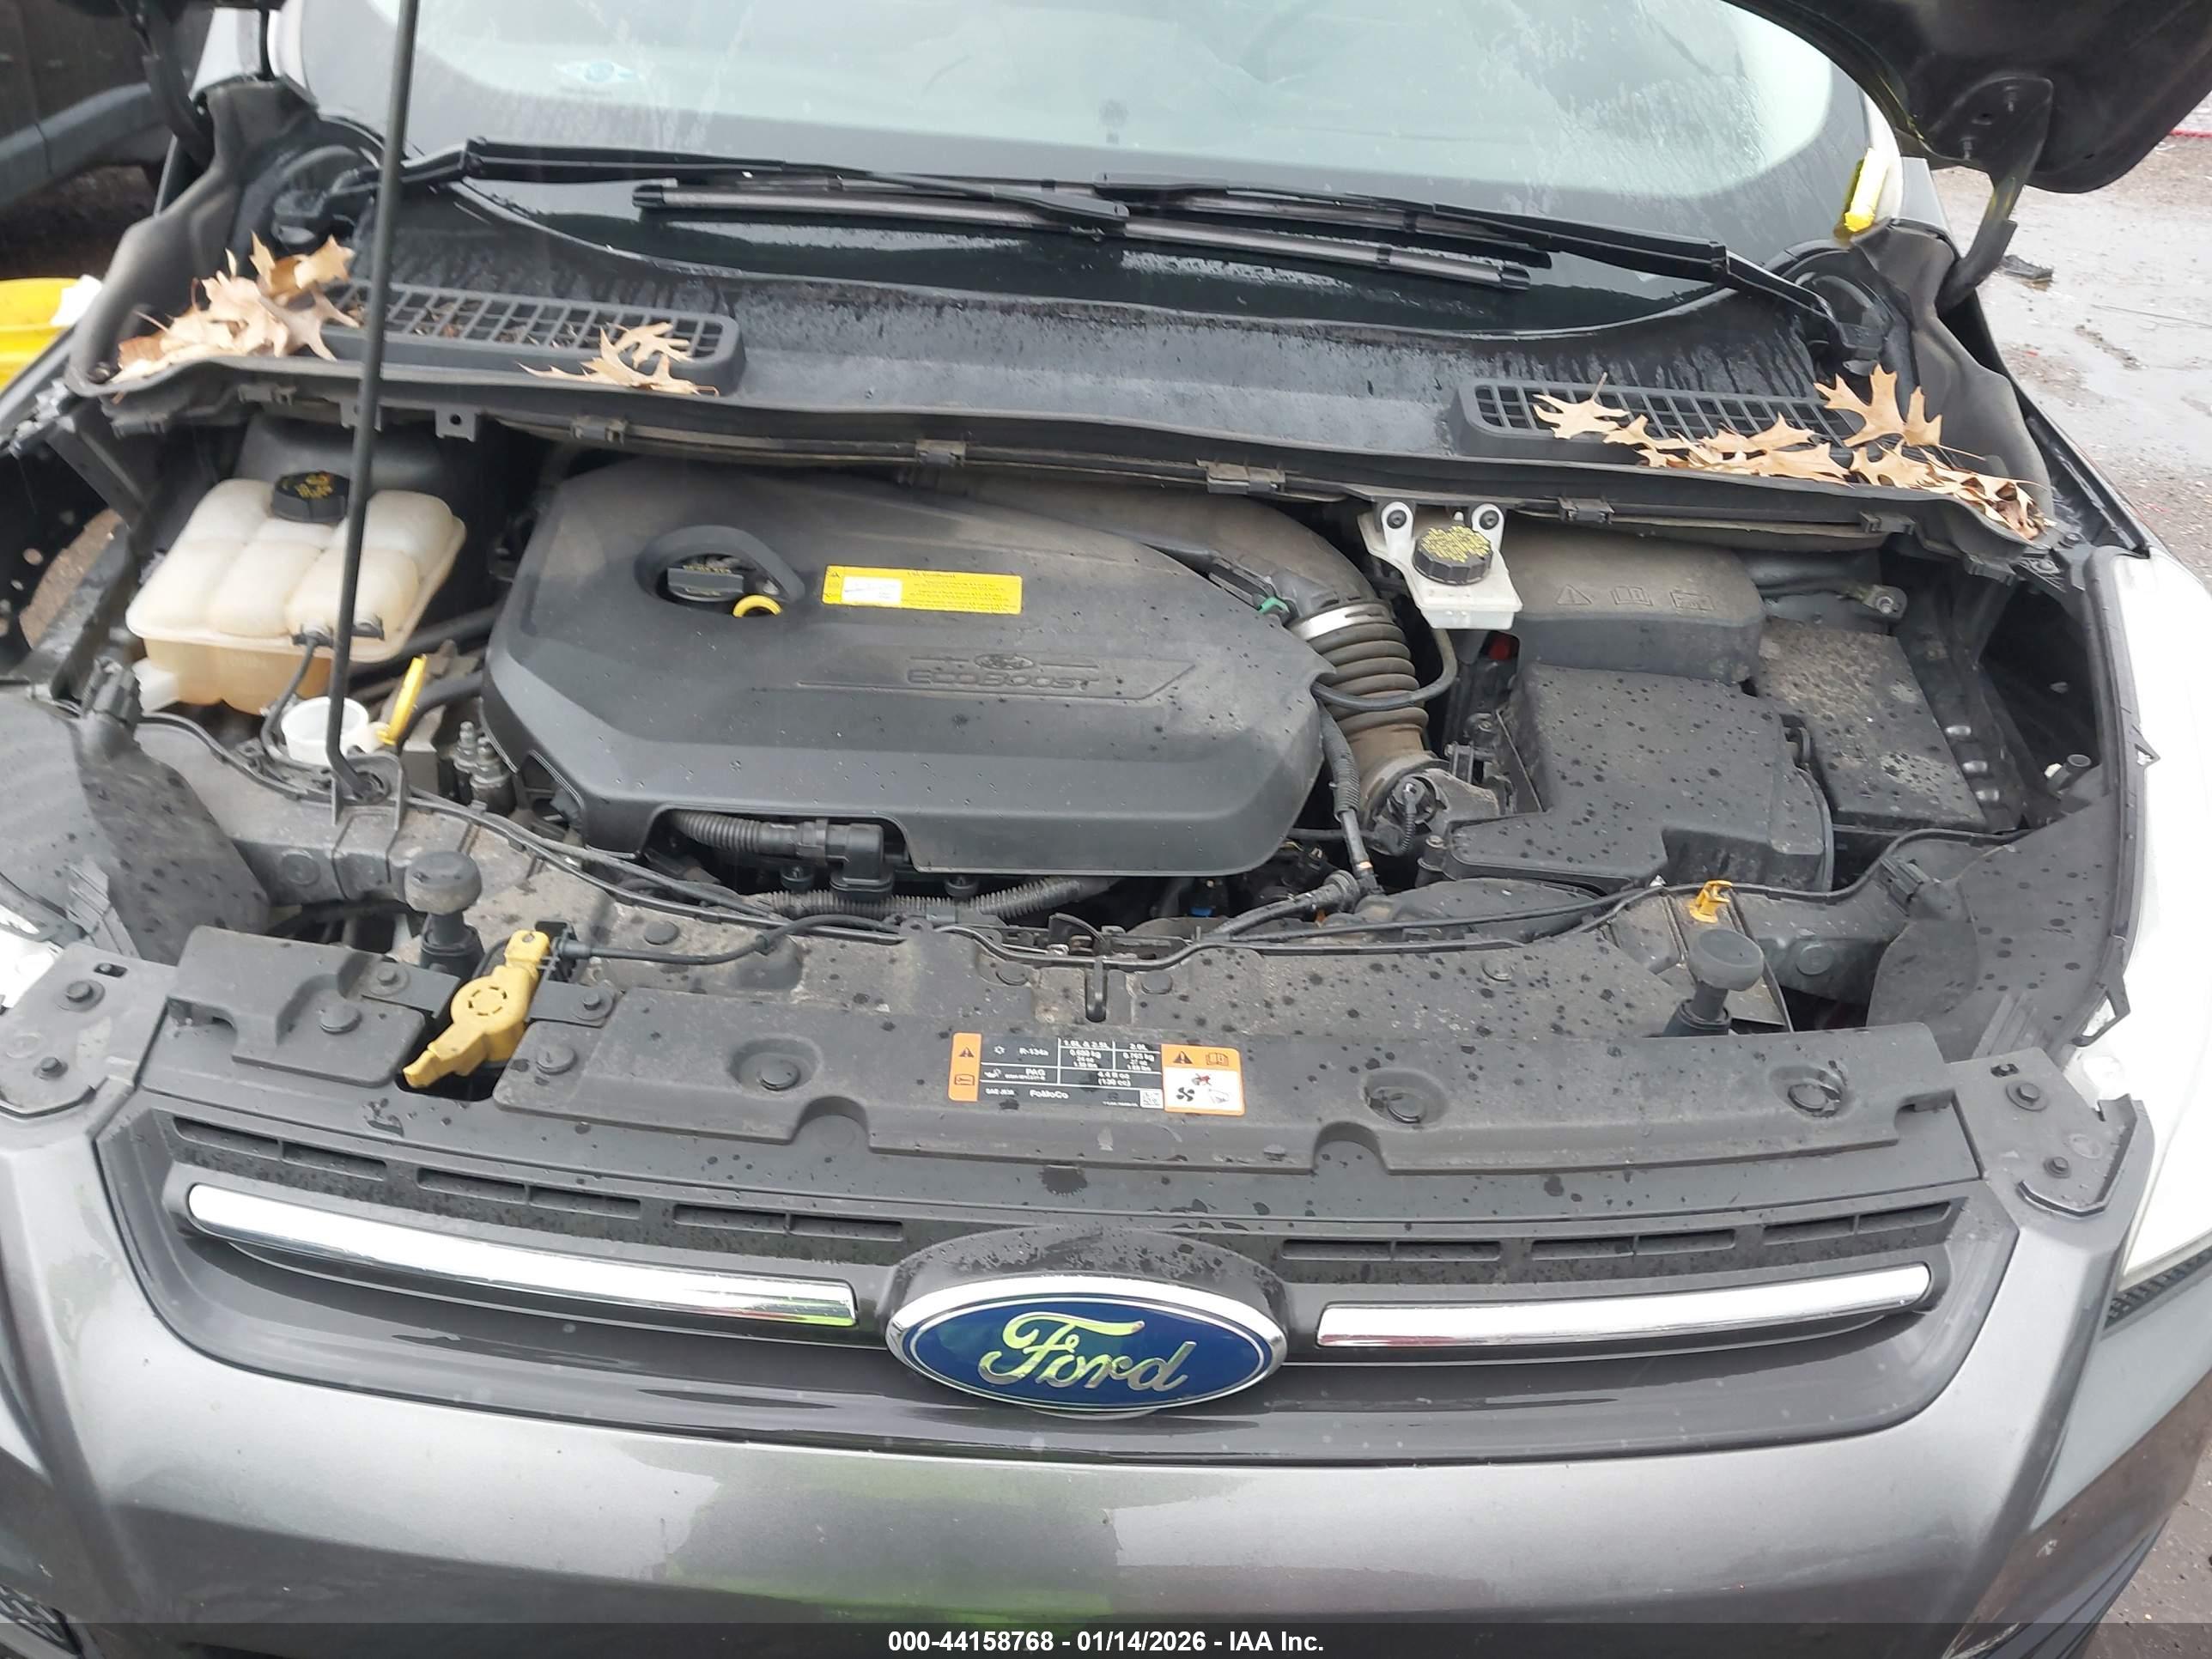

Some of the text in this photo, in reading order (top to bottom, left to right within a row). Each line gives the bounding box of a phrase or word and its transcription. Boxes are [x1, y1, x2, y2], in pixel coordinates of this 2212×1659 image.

[1018, 1047, 1049, 1056] R-134a
[1025, 1068, 1046, 1077] PAG
[1029, 1089, 1069, 1099] FoMoCo
[978, 1311, 1197, 1392] Ford
